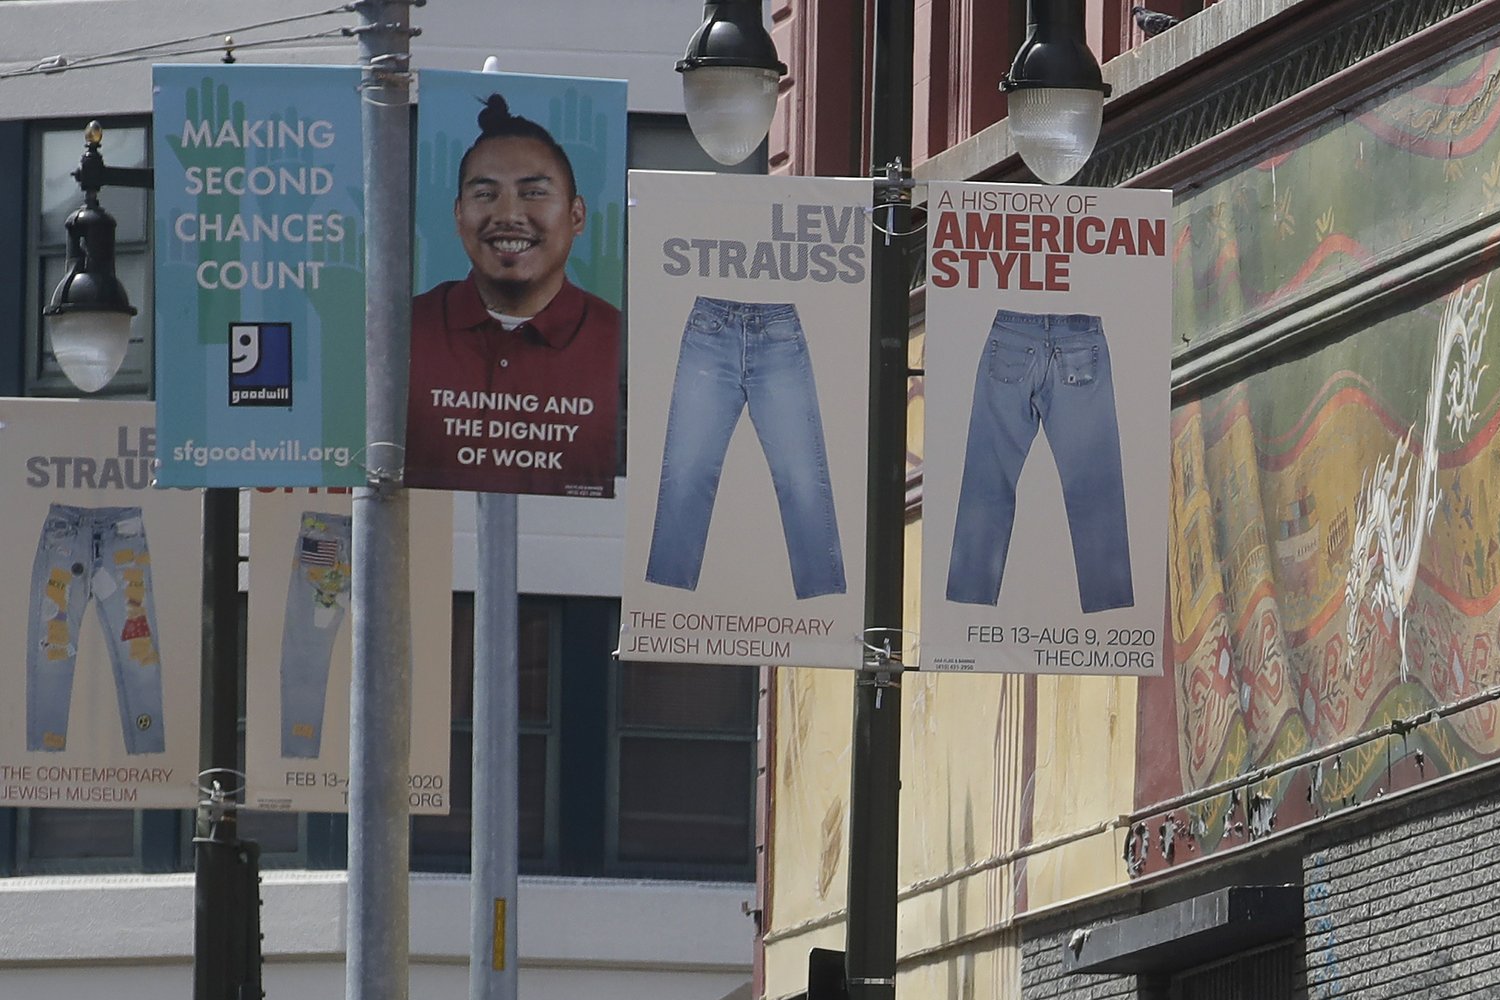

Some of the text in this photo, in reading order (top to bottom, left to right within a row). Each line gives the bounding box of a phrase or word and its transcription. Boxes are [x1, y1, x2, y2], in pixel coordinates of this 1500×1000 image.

[181, 119, 335, 148] MAKING
[185, 166, 334, 195] SECOND
[937, 190, 1097, 214] A HISTORY OF
[174, 213, 345, 242] CHANCES
[771, 202, 866, 245] LEVI
[932, 212, 1165, 256] AMERICAN
[662, 238, 866, 284] STRAUSS
[931, 249, 1070, 292] STYLE
[196, 260, 325, 289] COUNT
[232, 387, 289, 404] goodwill
[430, 389, 595, 416] TRAINING AND
[443, 417, 579, 443] THE DIGNITY
[173, 439, 350, 467] sfgoodwill.org
[457, 446, 564, 470] OF WORK
[630, 611, 834, 636] THE CONTEMPORARY
[967, 626, 1155, 647] FEB 13-AUG 9, 2020
[627, 635, 791, 658] JEWISH MUSEUM
[1034, 649, 1154, 668] THECJM.ORG
[1, 765, 174, 783] THE CONTEMPORARY
[285, 771, 316, 787] FEB
[1, 785, 138, 802] JEWISH MUSEUM
